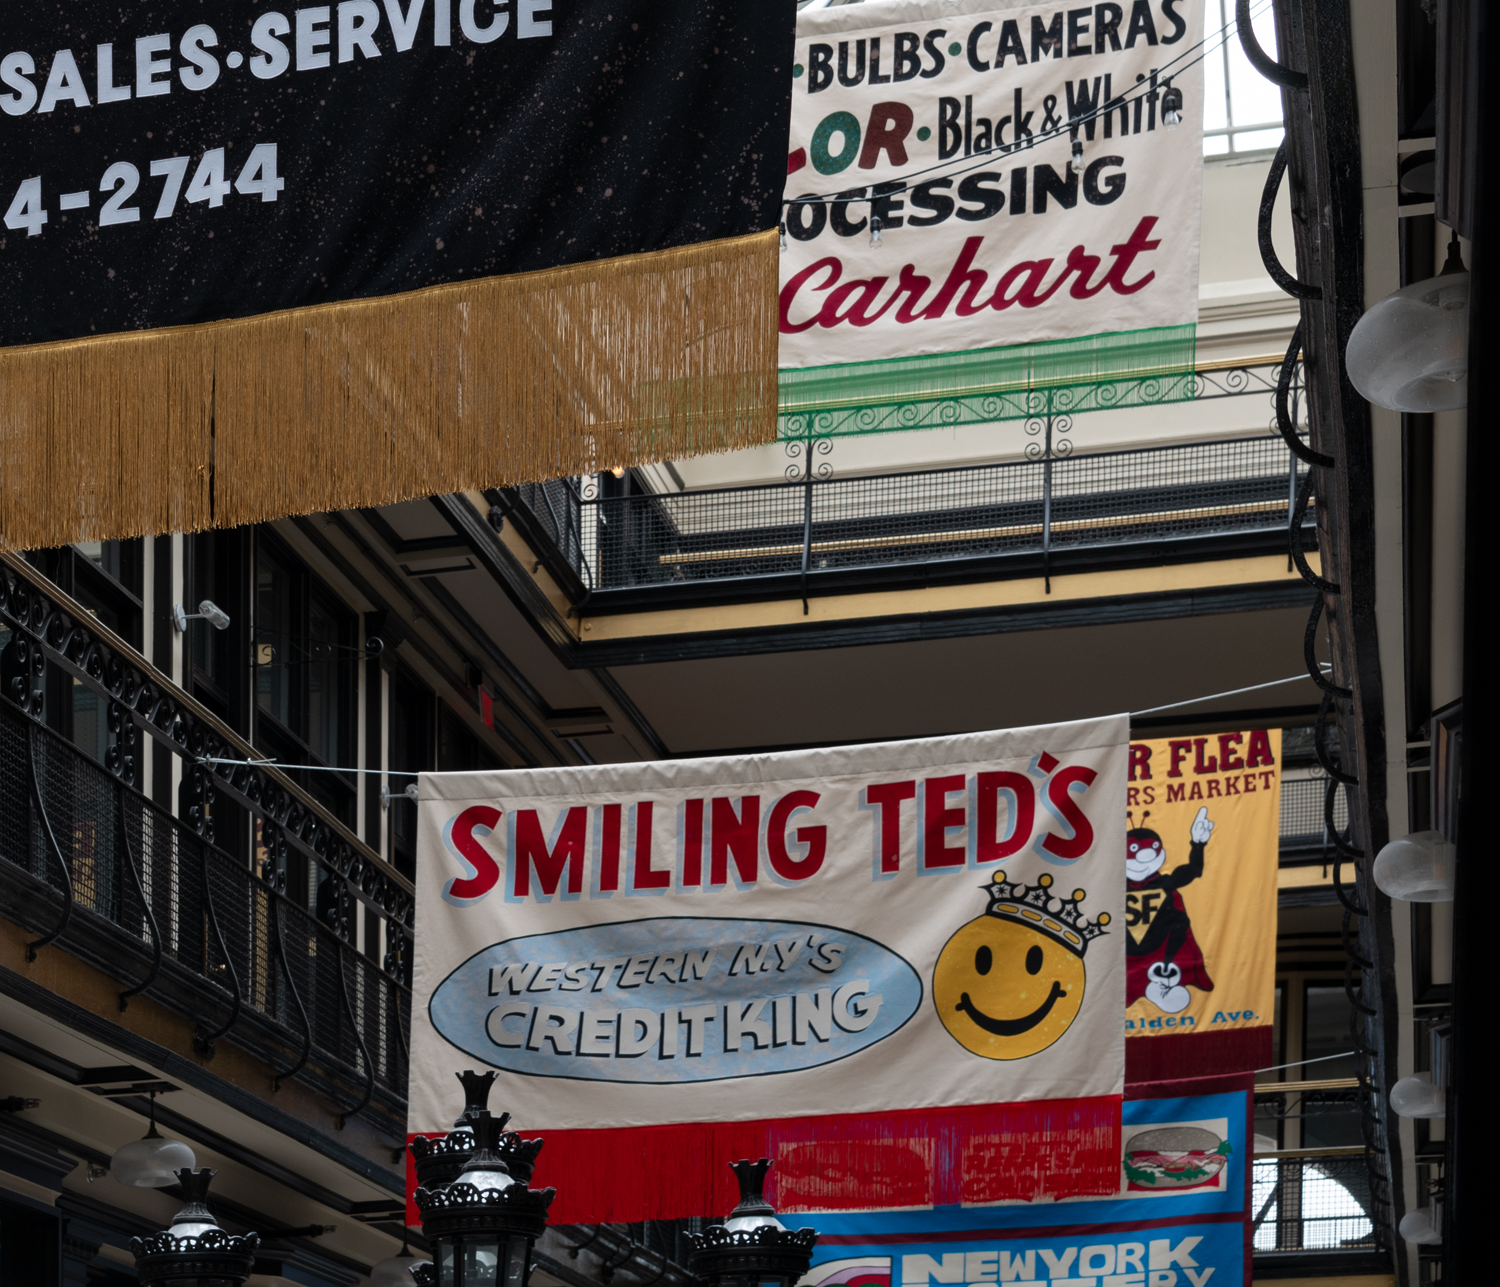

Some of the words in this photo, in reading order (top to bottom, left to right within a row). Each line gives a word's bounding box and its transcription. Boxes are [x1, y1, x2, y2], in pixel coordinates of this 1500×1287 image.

[778, 216, 1162, 334] Carhart
[1167, 730, 1274, 778] FLEA
[1166, 770, 1275, 803] MARKET
[442, 790, 827, 907] SMILING
[859, 750, 1098, 881] TED'S
[1126, 892, 1161, 927] SF
[488, 948, 718, 996] WESTERN
[728, 934, 847, 977] N.Y'S
[1211, 1010, 1260, 1024] Ave.
